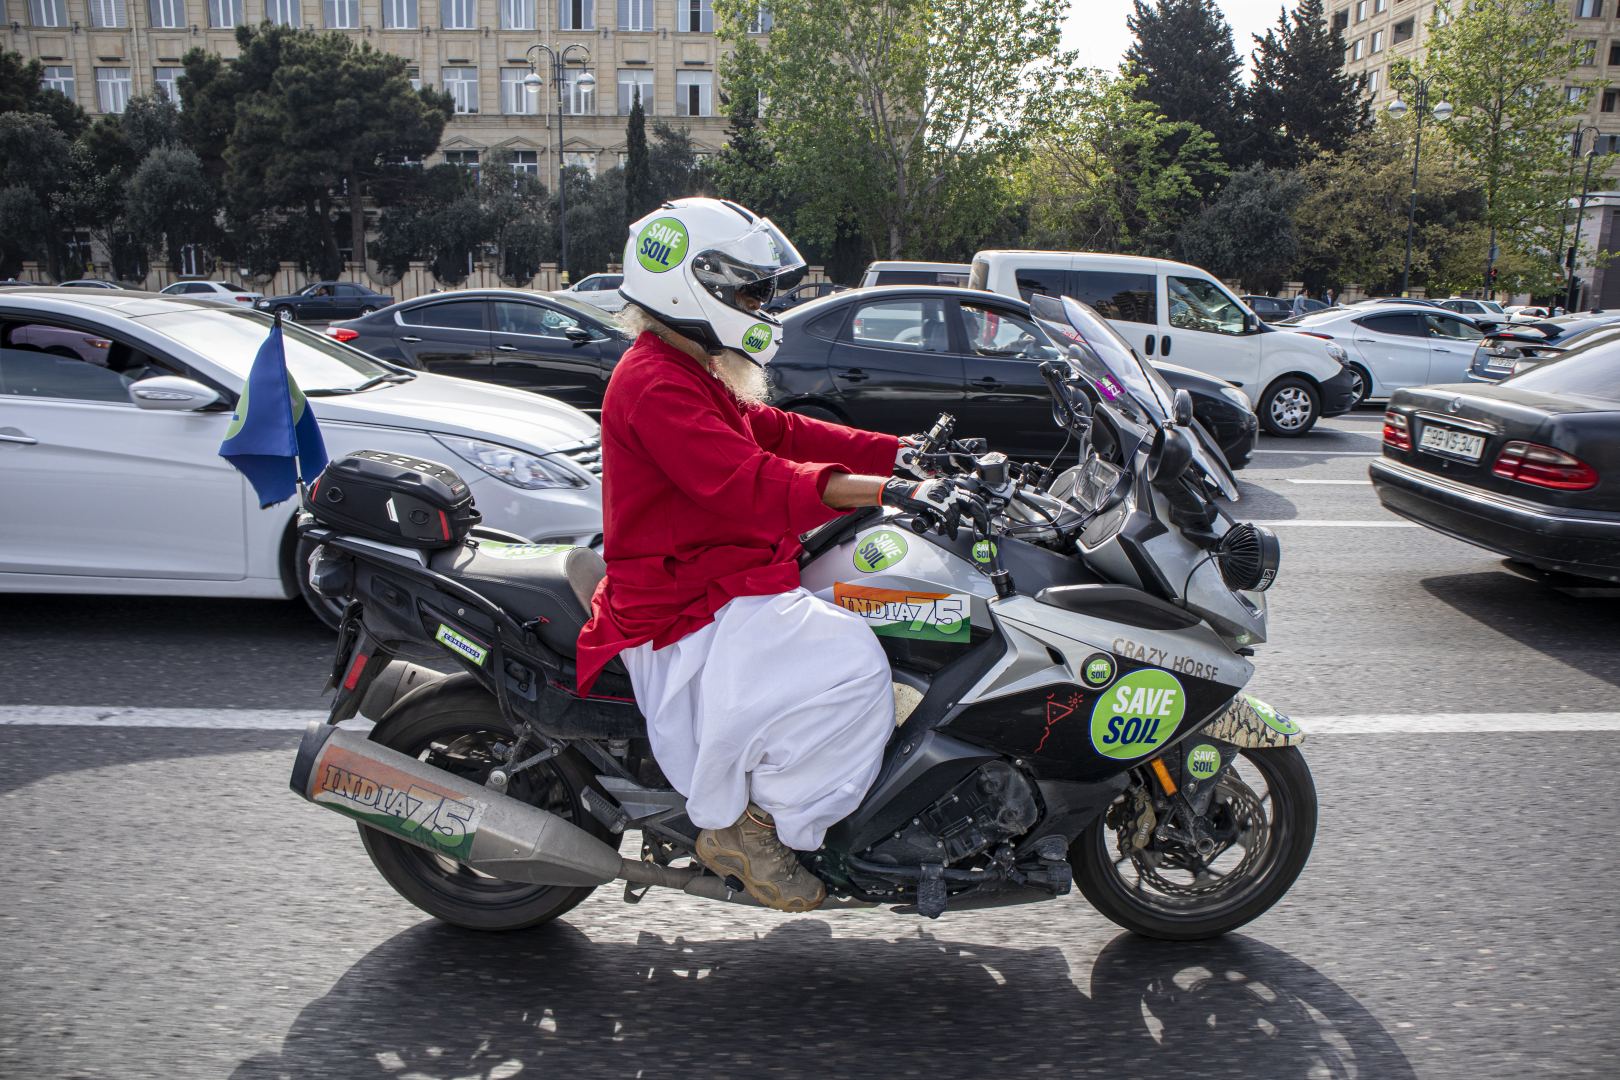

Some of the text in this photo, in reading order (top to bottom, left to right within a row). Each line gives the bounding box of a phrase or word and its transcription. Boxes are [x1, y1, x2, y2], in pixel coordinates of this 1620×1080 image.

[648, 222, 683, 248] SAVE
[640, 237, 672, 266] SOIL
[745, 336, 764, 350] SOIL
[751, 326, 770, 341] SAVE
[859, 542, 885, 569] SOIL
[874, 533, 902, 559] SAVE
[976, 543, 992, 551] SAV
[976, 551, 990, 559] SOI
[443, 632, 480, 659] CONSCIOUS
[1091, 663, 1108, 672] SAVE
[1112, 638, 1219, 682] CRAZY HORSE
[1091, 671, 1107, 680] SOIL
[1112, 685, 1177, 716] SAVE
[1102, 715, 1161, 745] SOIL
[1193, 750, 1216, 761] SAVE
[1192, 761, 1214, 773] SOIL
